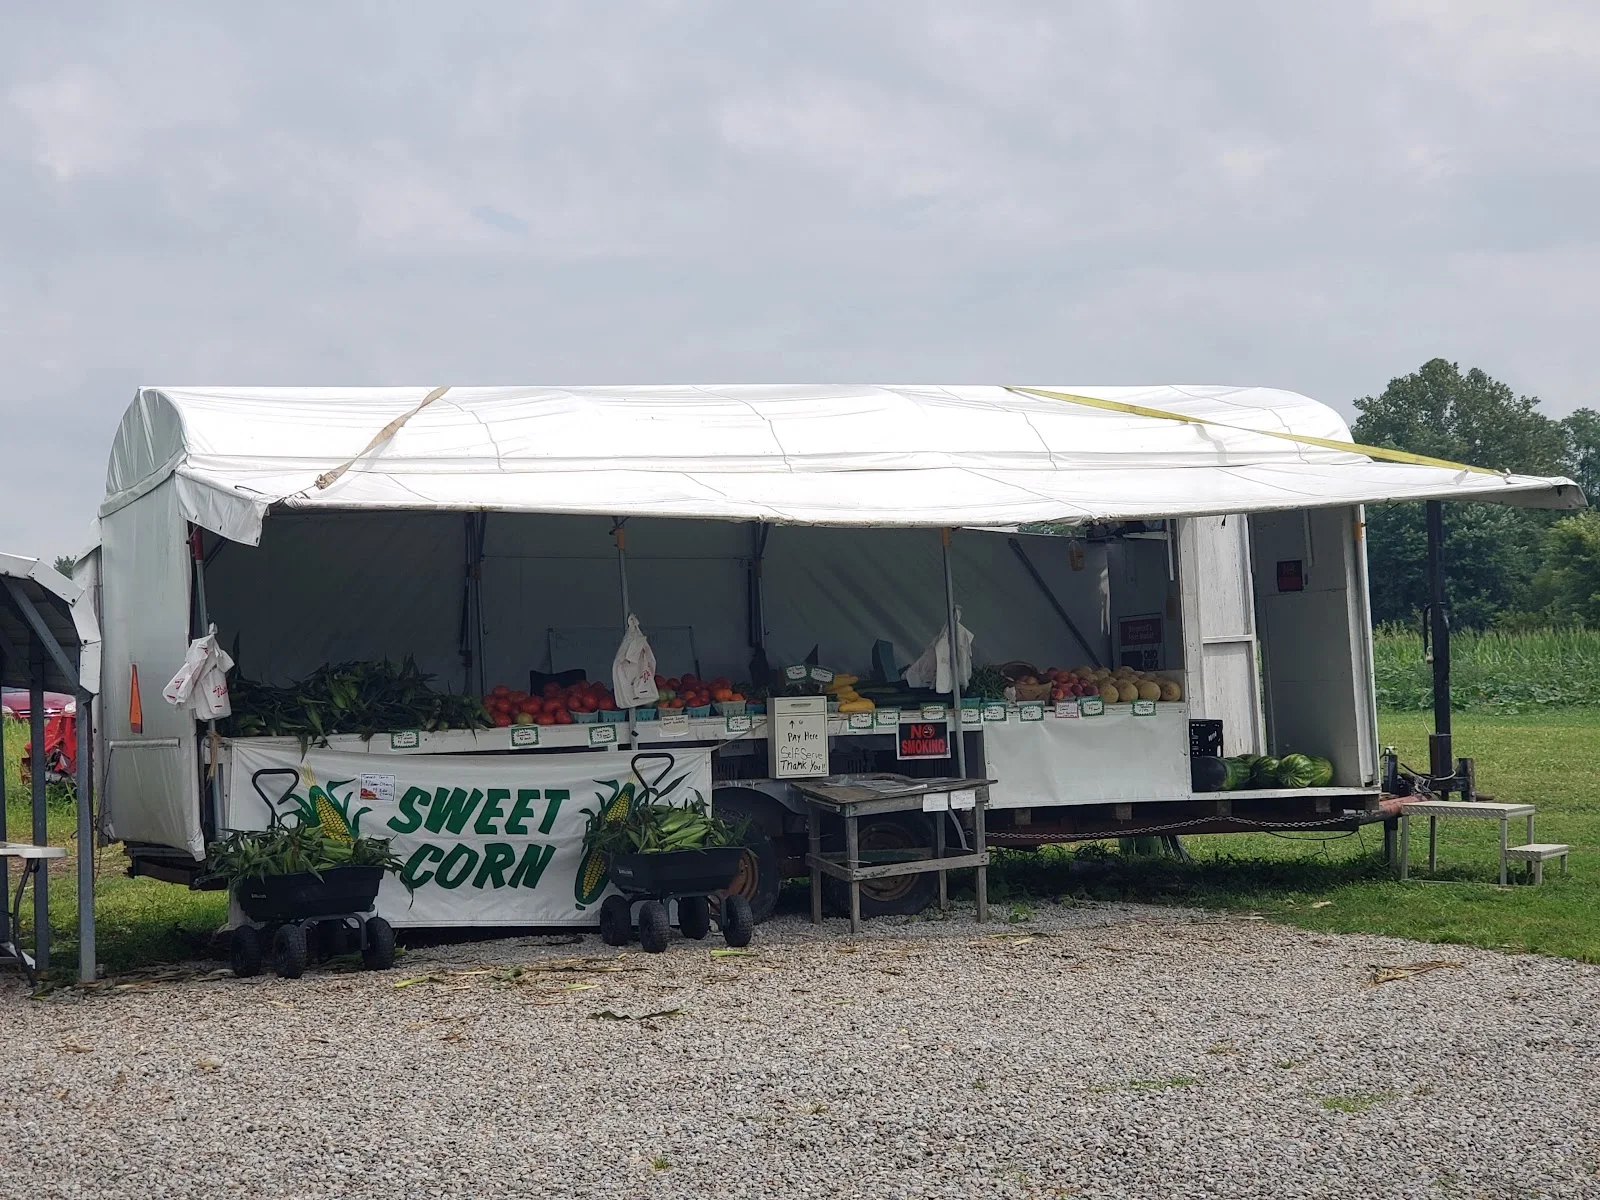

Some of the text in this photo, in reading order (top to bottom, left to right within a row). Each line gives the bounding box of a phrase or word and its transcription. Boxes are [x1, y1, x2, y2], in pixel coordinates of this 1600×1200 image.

[804, 731, 818, 741] Here
[902, 738, 945, 754] SMOKING
[780, 759, 807, 771] Thank
[386, 786, 571, 836] SWEET
[399, 842, 557, 890] CORN
